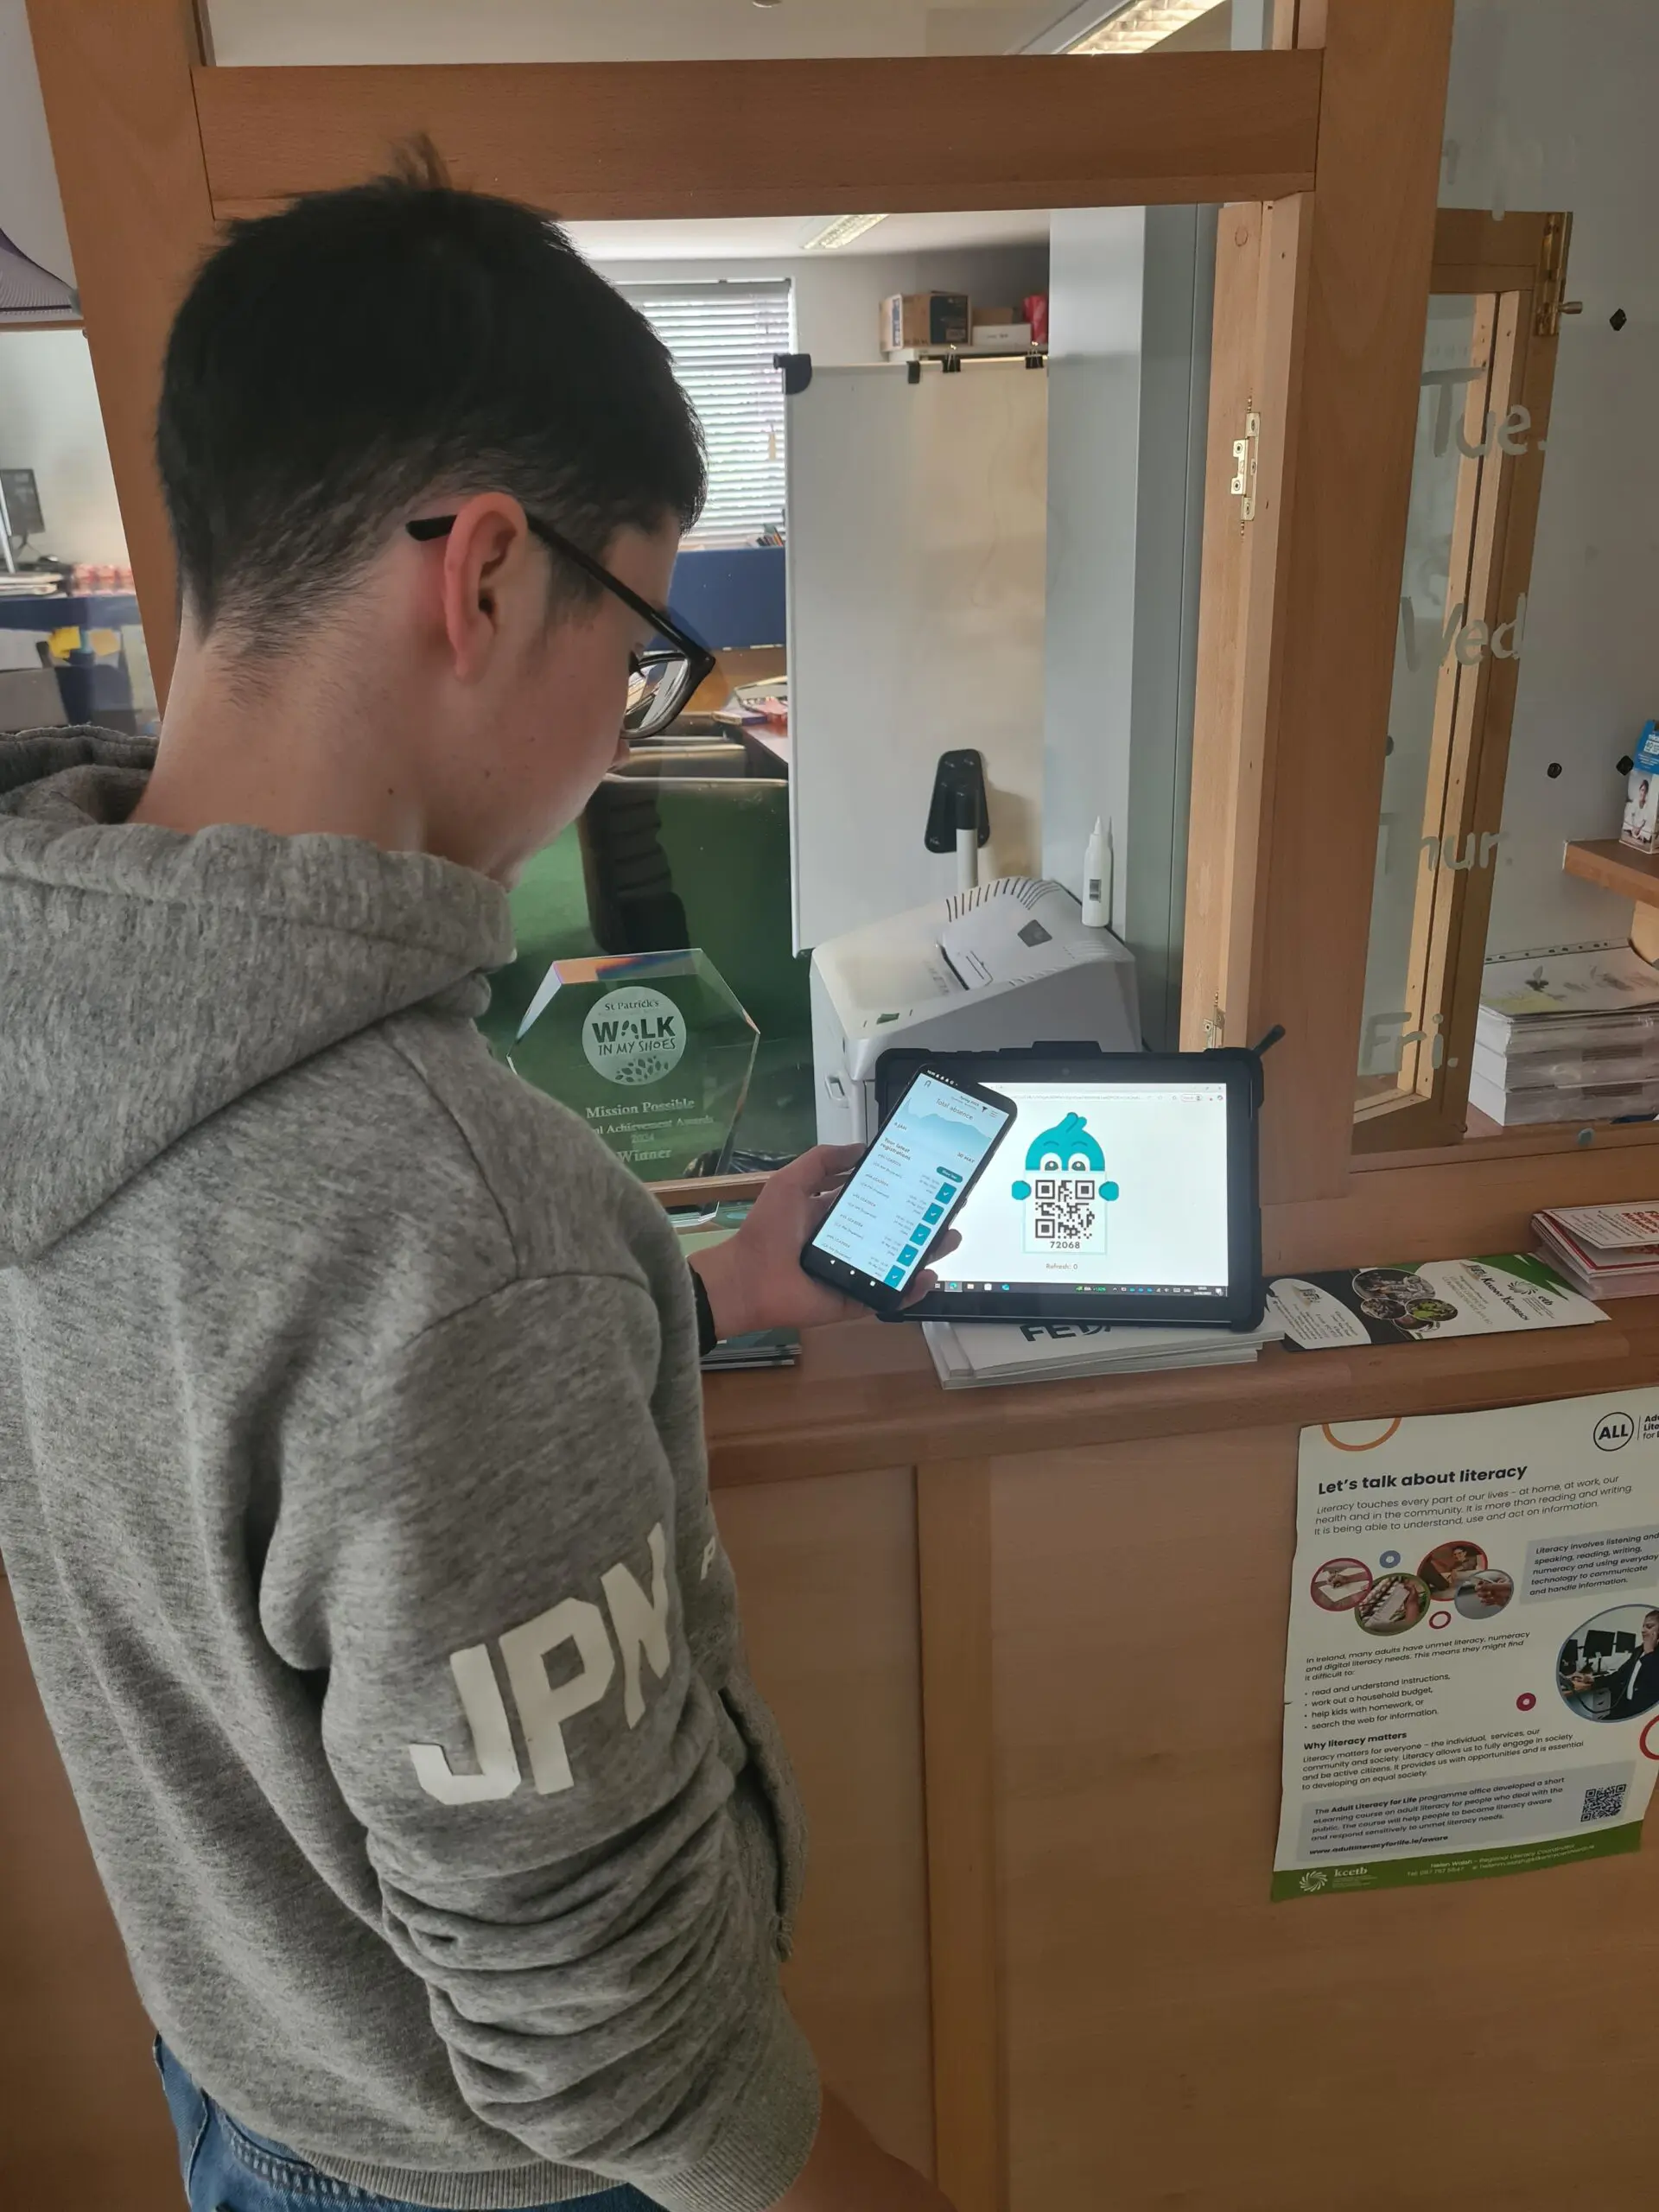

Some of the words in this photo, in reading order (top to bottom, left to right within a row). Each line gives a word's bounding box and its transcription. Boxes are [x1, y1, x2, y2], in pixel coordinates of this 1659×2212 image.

[618, 999, 659, 1010] Patrick's
[598, 1044, 613, 1056] IN
[616, 1041, 635, 1054] MY
[639, 1038, 676, 1052] SHOES
[585, 1104, 639, 1119] Mission
[642, 1098, 695, 1113] Possible
[936, 1098, 949, 1109] Total
[949, 1105, 974, 1121] absence
[607, 1120, 672, 1134] Achievement
[617, 1149, 672, 1163] Winner
[1050, 1241, 1080, 1249] 72068
[1599, 1424, 1629, 1440] ALL
[1319, 1479, 1357, 1495] Let's
[1363, 1475, 1398, 1489] talk
[1402, 1471, 1455, 1486] about
[1459, 1465, 1528, 1482] literacy
[1317, 1502, 1354, 1514] Literacy
[1357, 1500, 1399, 1510] touches
[1402, 1497, 1429, 1507] every
[1432, 1495, 1452, 1506] part
[1488, 1490, 1508, 1498] lives
[1519, 1487, 1529, 1496] at
[1531, 1484, 1561, 1494] home,
[1564, 1481, 1574, 1490] at
[1577, 1478, 1600, 1488] work,
[1603, 1476, 1619, 1484] our
[1315, 1513, 1346, 1524] health
[1349, 1512, 1370, 1521] and
[1373, 1511, 1382, 1520] in
[1384, 1510, 1401, 1519] the
[1404, 1506, 1463, 1518] community.
[1475, 1503, 1482, 1511] is
[1485, 1501, 1511, 1510] more
[1514, 1498, 1536, 1507] than
[1538, 1492, 1576, 1503] reading
[1579, 1490, 1598, 1498] and
[1333, 1524, 1362, 1535] being
[1365, 1522, 1388, 1531] able
[1403, 1516, 1463, 1529] understand,
[1466, 1515, 1484, 1523] use
[1486, 1512, 1506, 1521] and
[1509, 1510, 1524, 1518] act
[1535, 1544, 1568, 1554] Literacy
[1570, 1540, 1604, 1550] involves
[1606, 1535, 1641, 1546] listening
[1532, 1564, 1575, 1575] numeracy
[1596, 1558, 1618, 1567] using
[1620, 1554, 1659, 1565] everyday
[1534, 1554, 1574, 1566] speaking,
[1577, 1550, 1611, 1560] reading,
[1531, 1573, 1578, 1586] technology
[1590, 1565, 1648, 1578] communicate
[1529, 1587, 1546, 1596] and
[1548, 1584, 1577, 1593] handle
[1348, 1649, 1373, 1659] many
[1375, 1647, 1401, 1656] adults
[1402, 1643, 1423, 1652] have
[1425, 1640, 1452, 1649] unmet
[1488, 1630, 1531, 1642] numeracy
[409, 1522, 671, 1805] JPN
[1324, 1661, 1351, 1671] digital
[1351, 1657, 1382, 1667] literacy
[1385, 1655, 1412, 1663] needs.
[1432, 1649, 1460, 1657] means
[1462, 1644, 1480, 1654] they
[1482, 1642, 1506, 1652] might
[1312, 1670, 1342, 1681] difficult
[1312, 1688, 1332, 1696] read
[1332, 1685, 1351, 1694] and
[1351, 1679, 1399, 1691] understand
[1401, 1673, 1451, 1685] instructions,
[1357, 1690, 1400, 1701] household
[1402, 1687, 1433, 1698] budget,
[1312, 1710, 1330, 1719] help
[1369, 1700, 1414, 1712] homework,
[1312, 1720, 1340, 1730] search
[1342, 1718, 1356, 1726] the
[1357, 1715, 1375, 1724] web
[1304, 1741, 1326, 1751] Why
[1328, 1737, 1366, 1747] literacy
[1368, 1732, 1408, 1743] matters
[1355, 1802, 1389, 1811] Literacy
[1419, 1789, 1468, 1802] programme
[1469, 1787, 1491, 1796] office
[1493, 1781, 1535, 1792] developed
